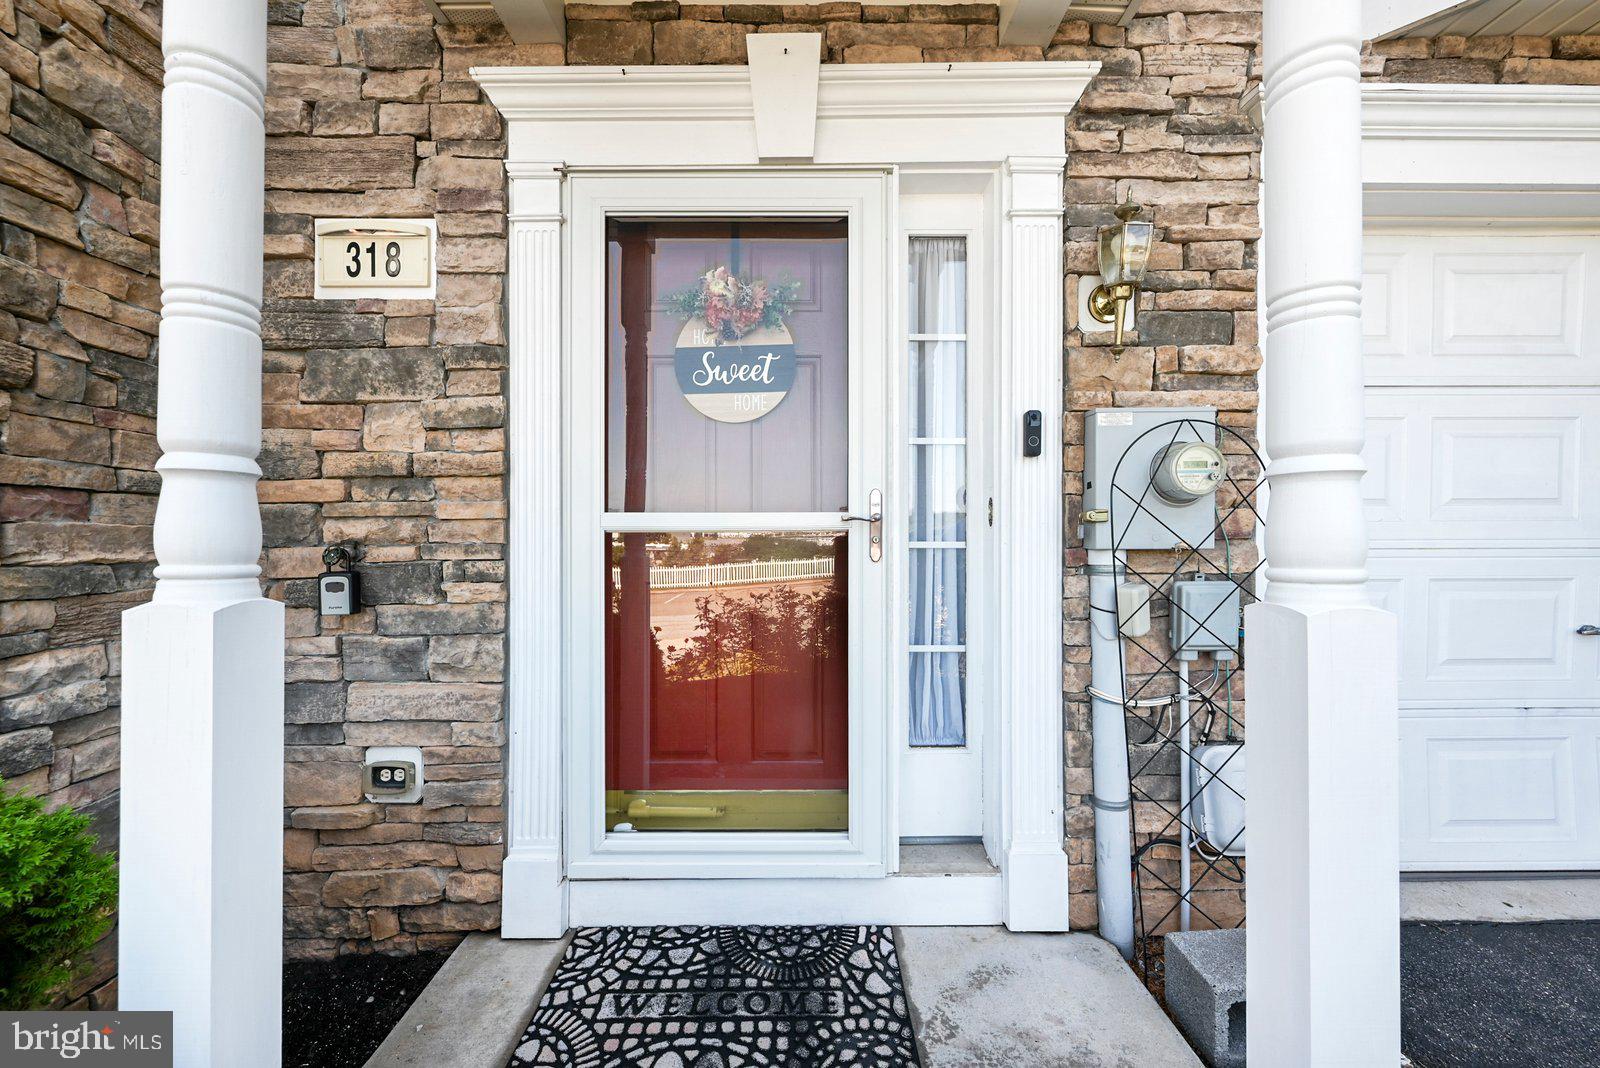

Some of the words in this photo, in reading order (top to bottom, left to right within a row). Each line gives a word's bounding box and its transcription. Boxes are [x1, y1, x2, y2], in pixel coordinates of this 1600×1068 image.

[346, 241, 401, 277] 318
[692, 351, 781, 387] Sweet
[734, 394, 768, 411] HOME
[612, 992, 840, 1017] WELCOME
